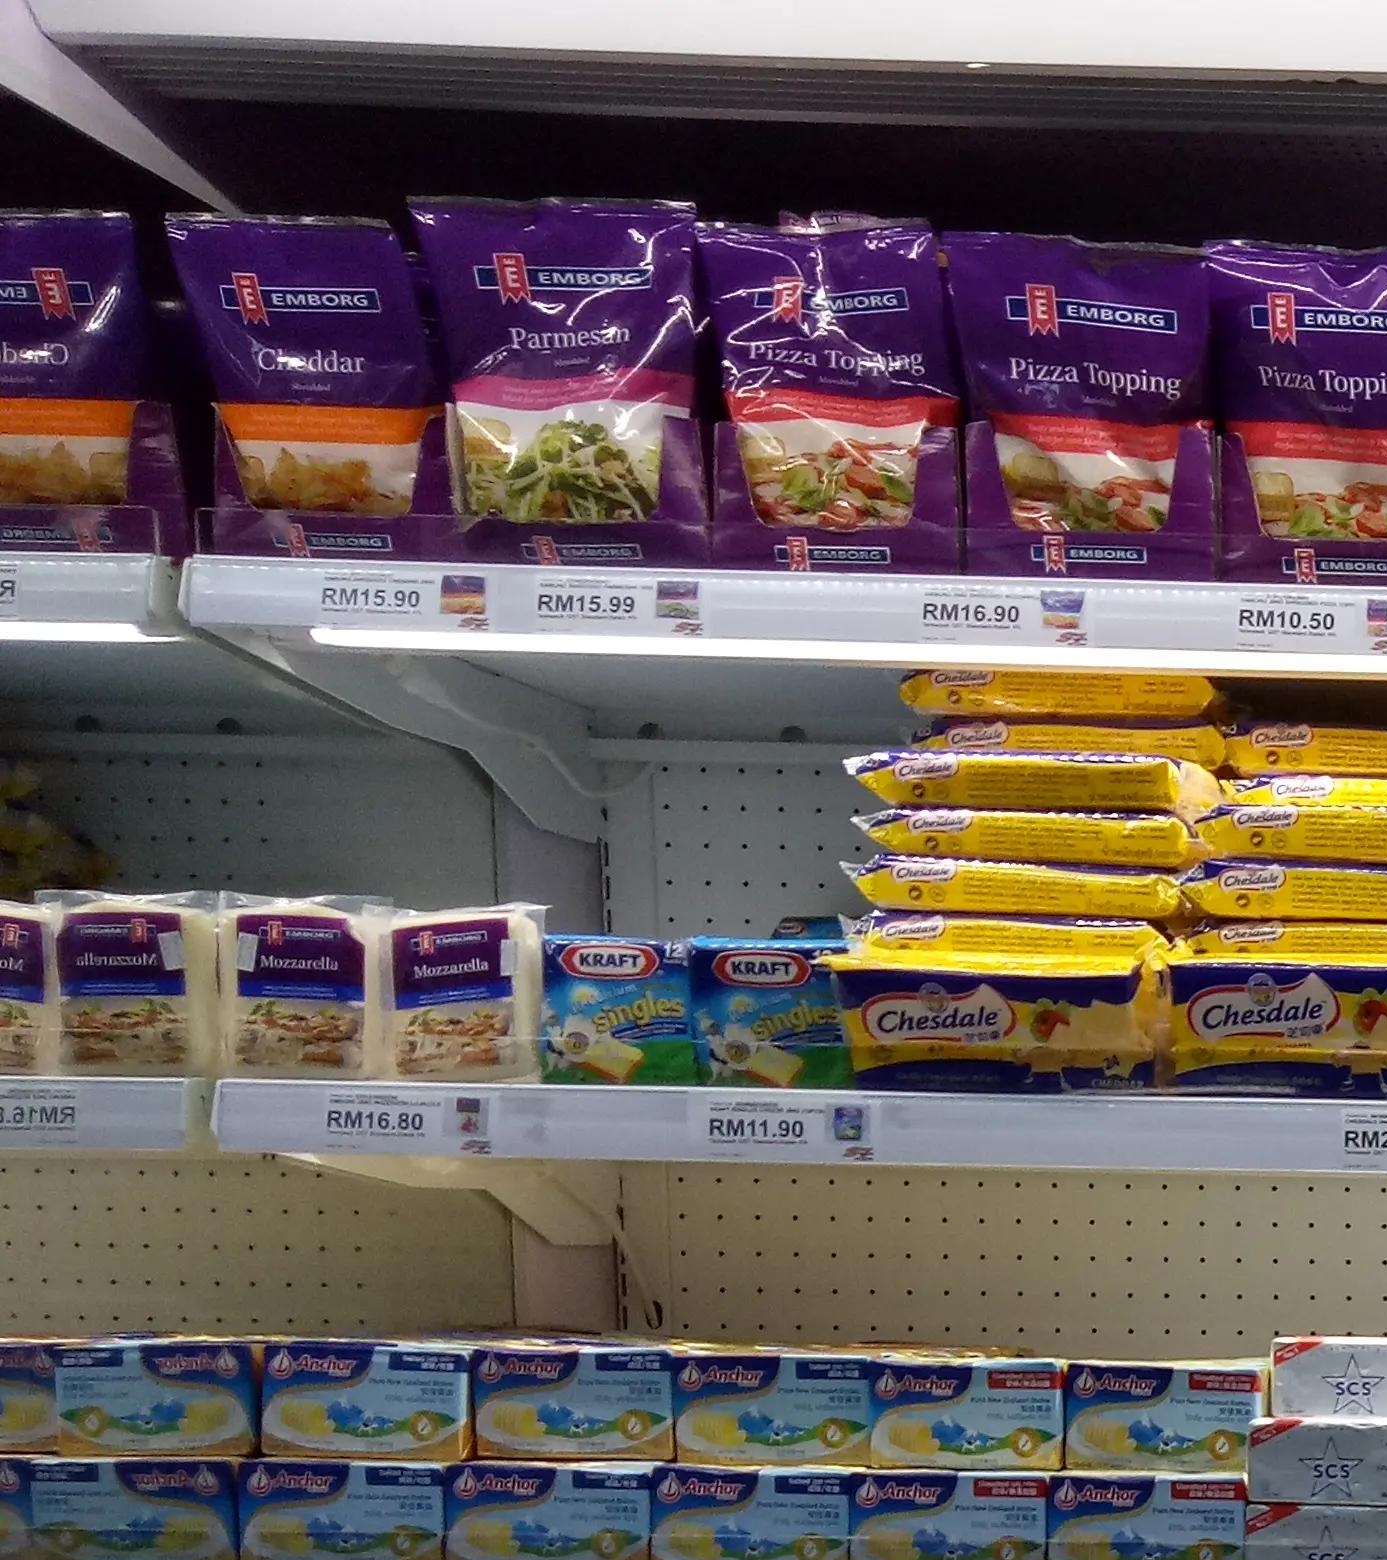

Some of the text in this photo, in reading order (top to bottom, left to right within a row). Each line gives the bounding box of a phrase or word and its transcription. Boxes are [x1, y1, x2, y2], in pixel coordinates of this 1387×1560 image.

[271, 291, 369, 307] EMBORG
[510, 324, 630, 350] Parmesan
[1009, 357, 1182, 398] Pizza Topping
[1259, 364, 1315, 389] Pizza
[322, 587, 421, 609] RM15.90
[538, 594, 635, 614] RM15.99
[922, 602, 1020, 625] RM16.90
[1238, 609, 1336, 631] RM10.50
[413, 958, 489, 979] Mozzarella
[730, 957, 794, 979] KRAFT
[590, 997, 687, 1034] singles
[875, 1006, 998, 1037] Chesdale
[326, 1110, 424, 1131] RM16.80
[708, 1117, 804, 1139] RM11.90
[294, 1356, 355, 1374] Anchor
[703, 1367, 764, 1387] Anchor
[1099, 1376, 1157, 1394] Anchor
